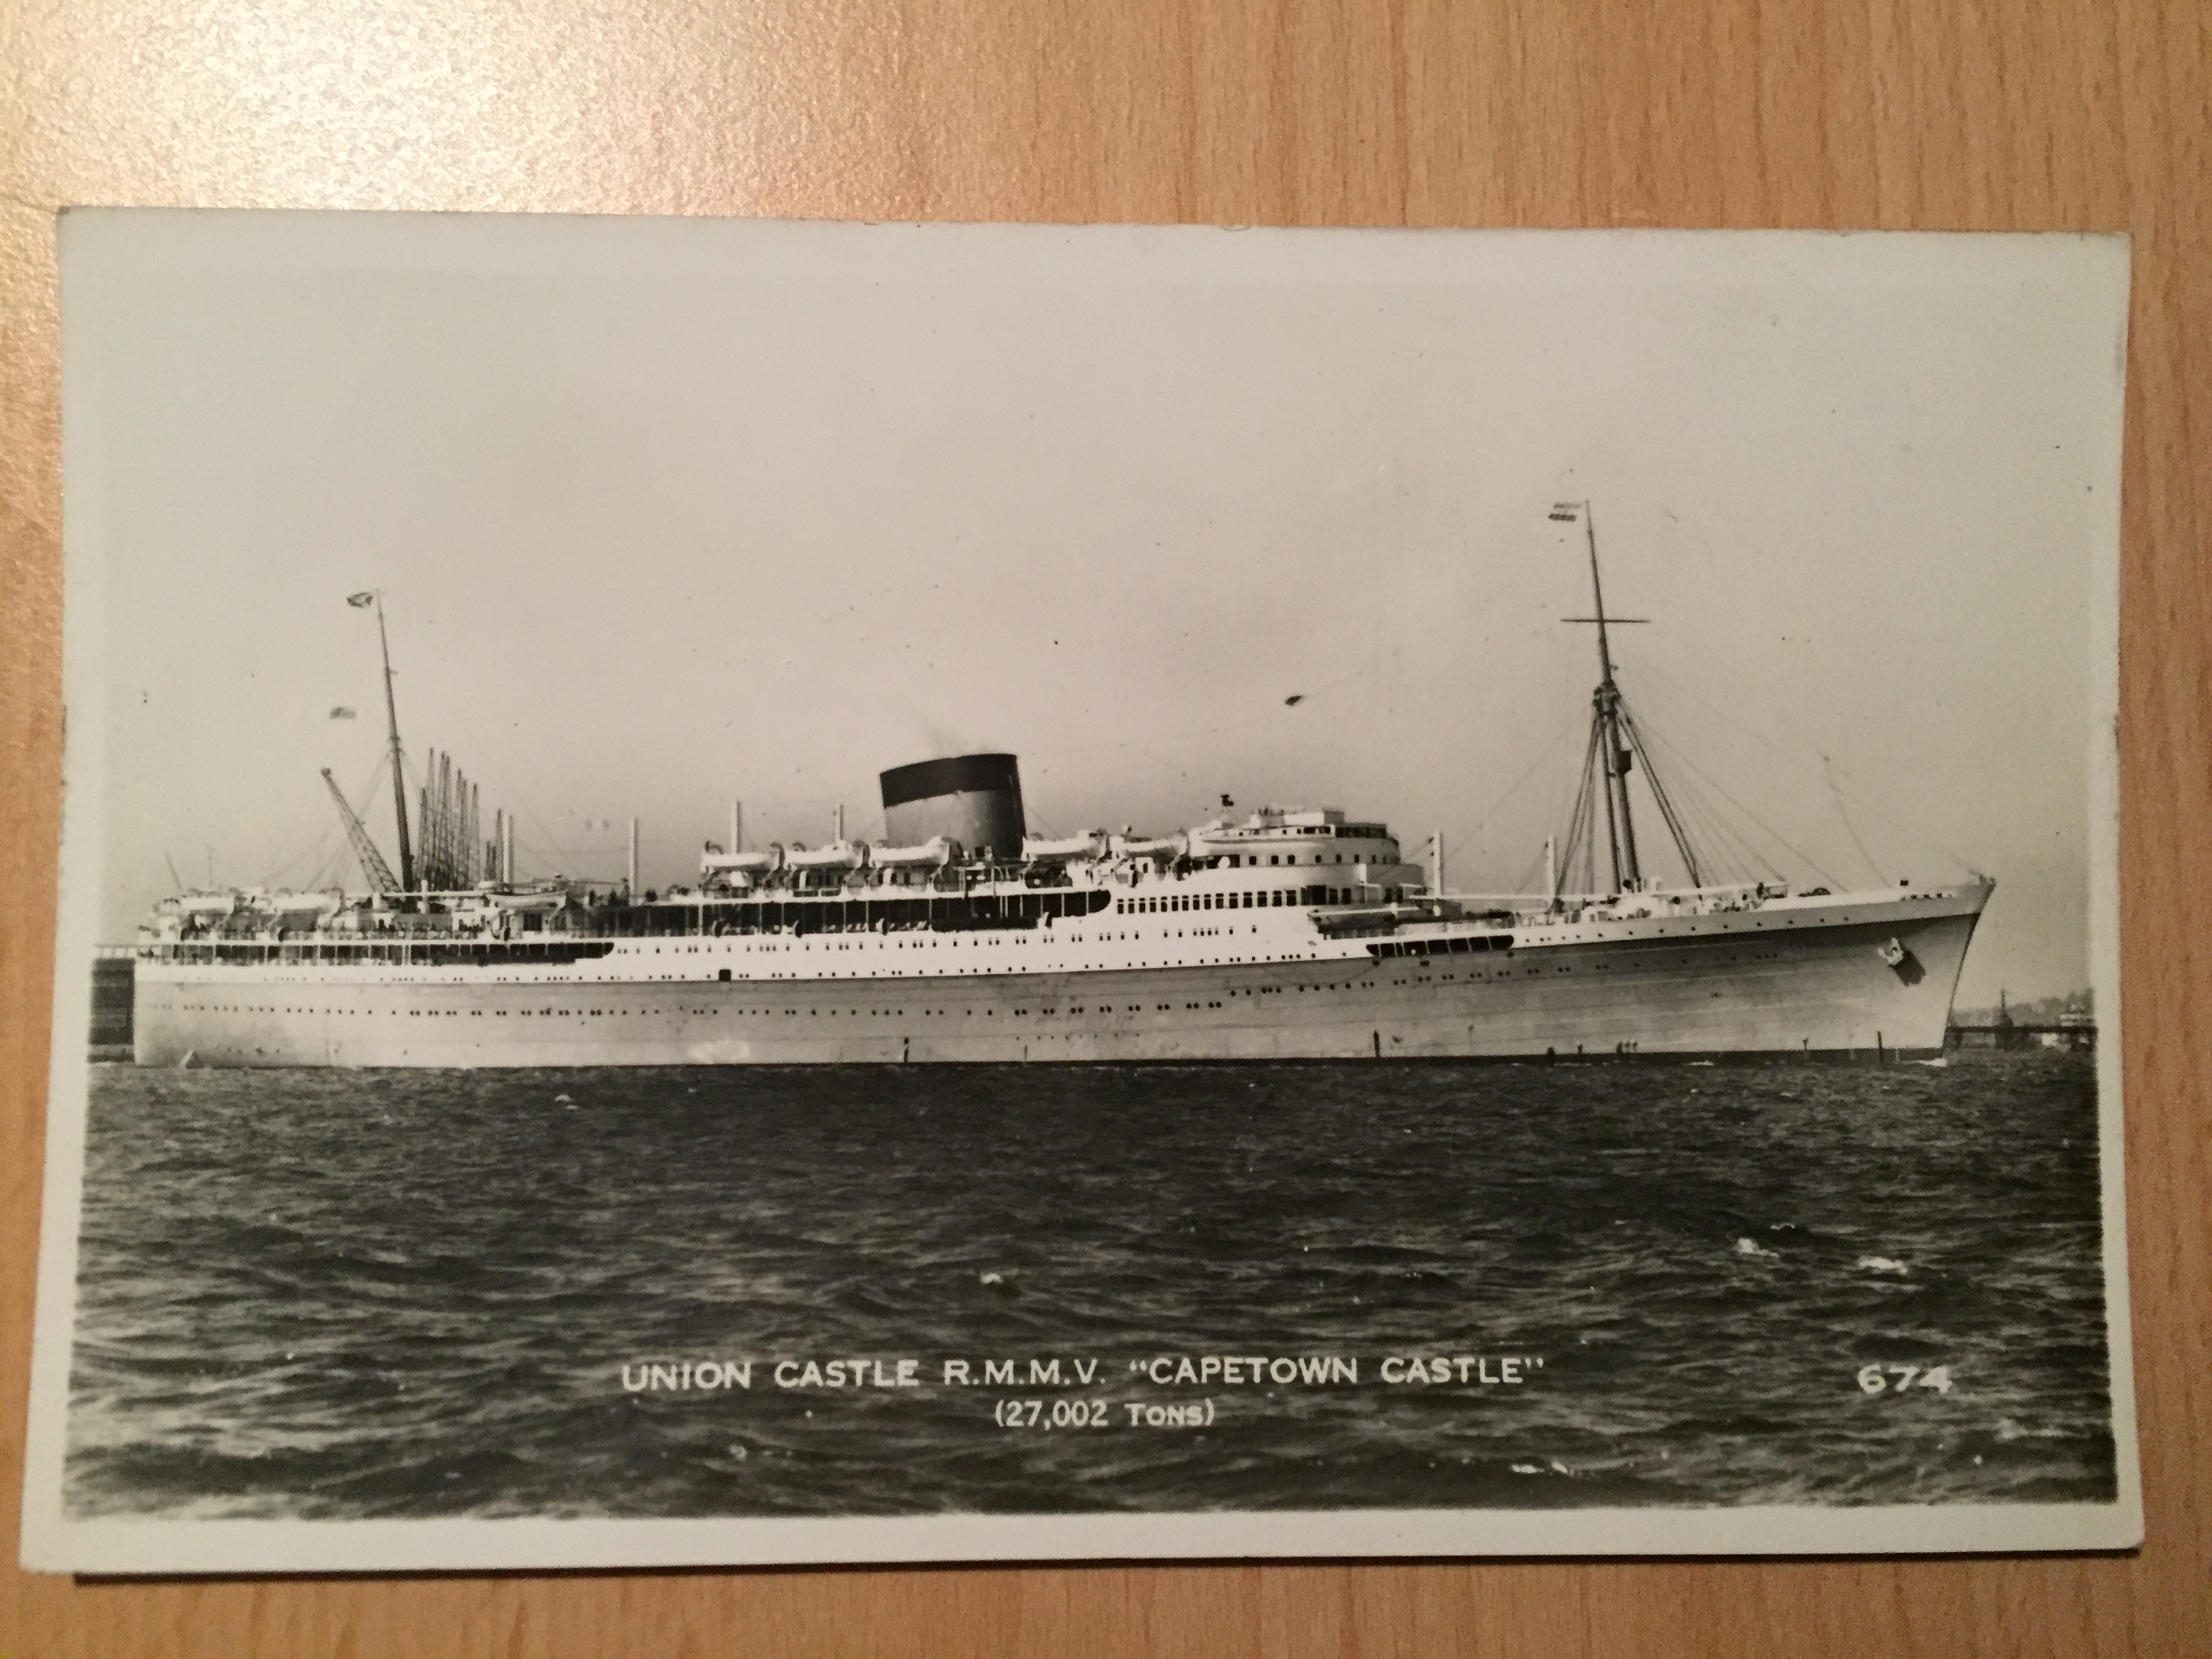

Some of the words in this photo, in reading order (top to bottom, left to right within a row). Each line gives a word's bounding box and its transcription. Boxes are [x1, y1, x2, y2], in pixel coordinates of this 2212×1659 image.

[621, 1361, 752, 1391] UNION
[775, 1359, 919, 1388] CASTLE
[944, 1357, 1106, 1386] R.M.M.V.
[1858, 1364, 1952, 1394] 674
[996, 1399, 1108, 1429] (27,002
